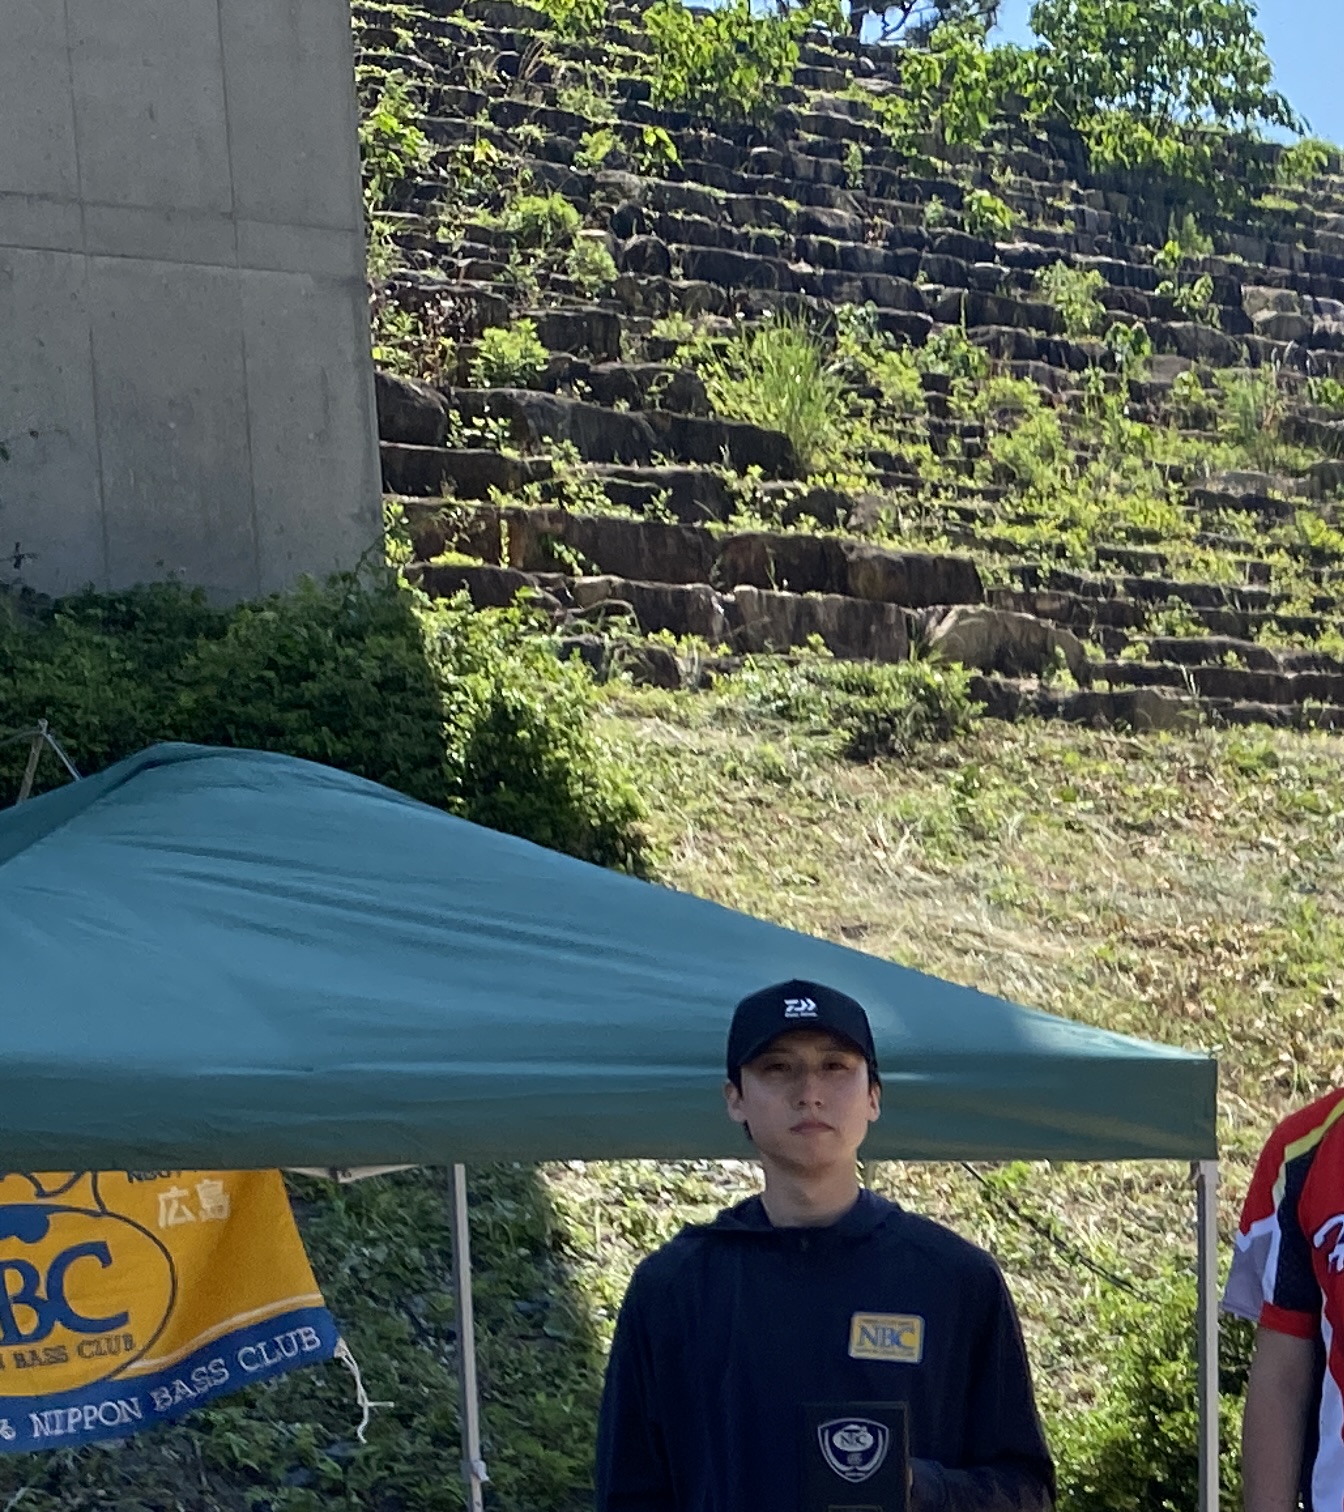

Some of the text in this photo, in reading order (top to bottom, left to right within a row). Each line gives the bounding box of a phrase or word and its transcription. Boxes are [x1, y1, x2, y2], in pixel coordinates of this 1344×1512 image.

[157, 1179, 231, 1229] 広島
[856, 1322, 916, 1350] NBC
[28, 1397, 143, 1438] NIPPON
[149, 1357, 231, 1412] BASS
[237, 1326, 322, 1373] CLUB
